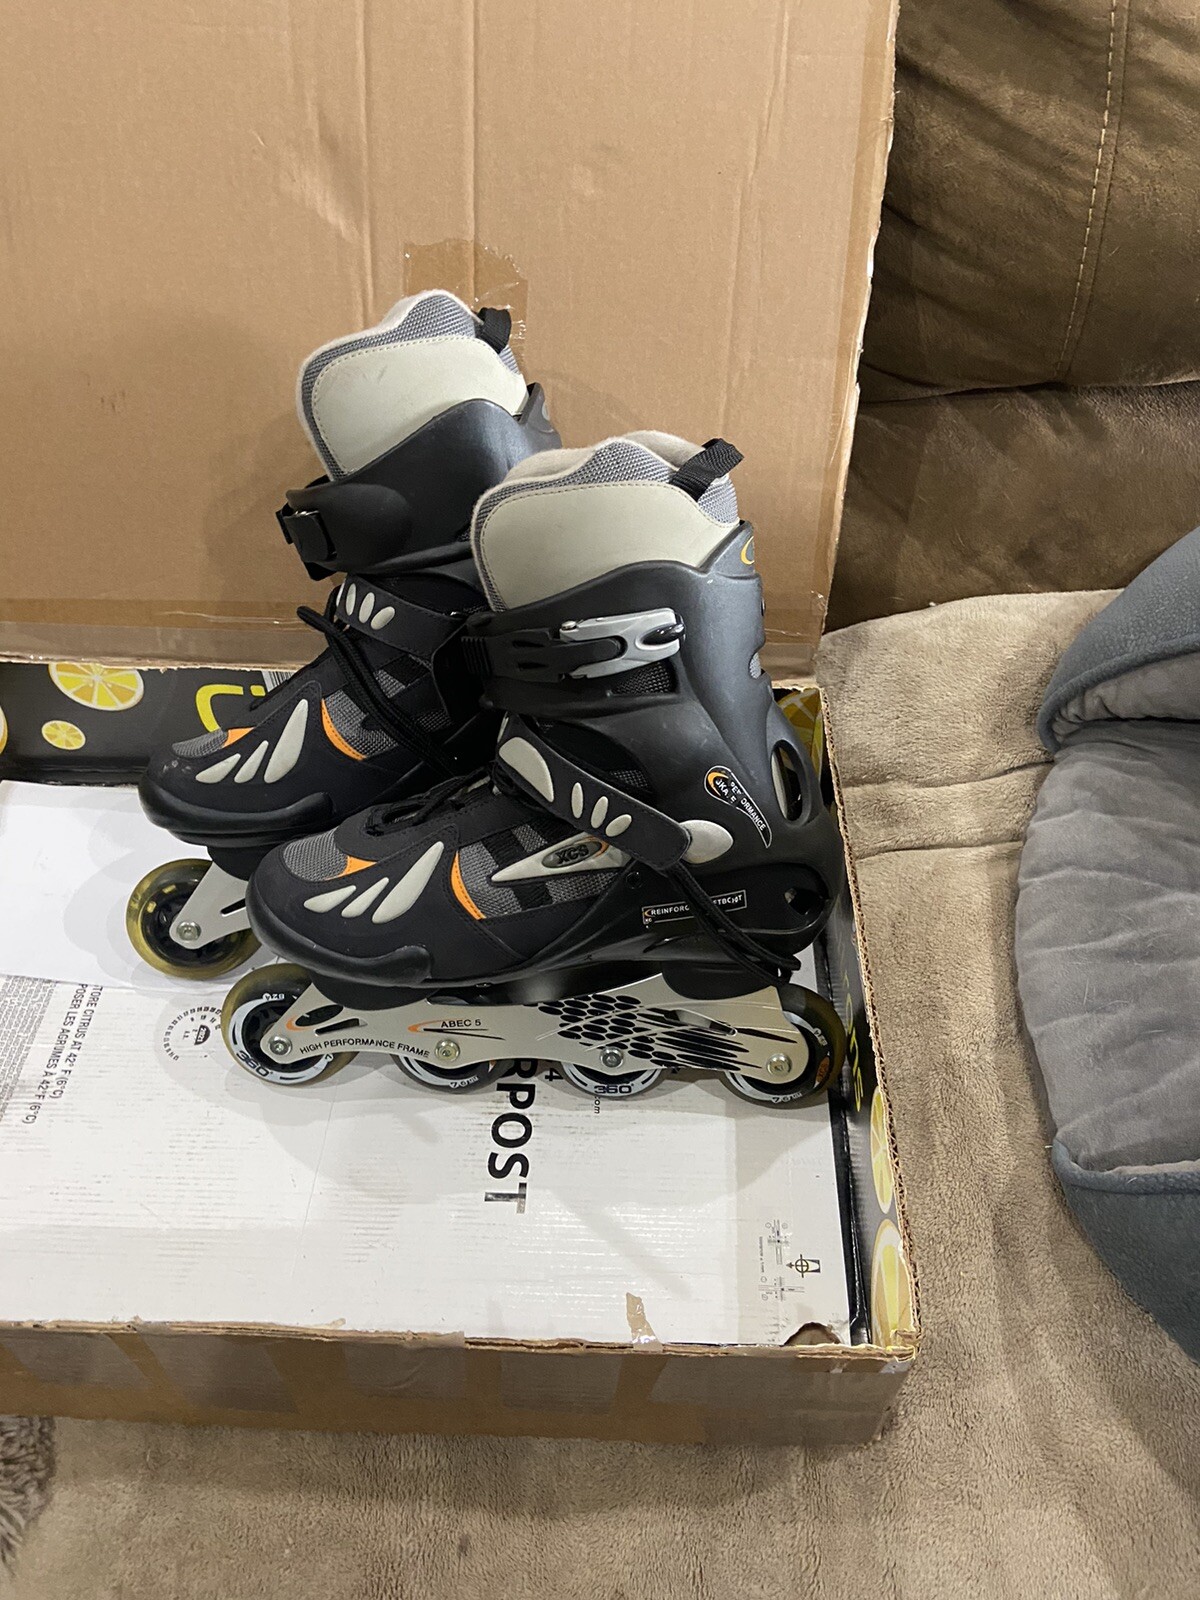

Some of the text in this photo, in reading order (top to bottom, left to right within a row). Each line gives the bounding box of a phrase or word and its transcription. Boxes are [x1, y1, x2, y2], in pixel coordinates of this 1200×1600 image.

[86, 984, 104, 1008] TORE
[63, 1011, 78, 1027] LES
[74, 1009, 95, 1039] CITRUS
[441, 1019, 472, 1028] ABEC
[46, 1028, 71, 1069] AGRUMES
[70, 1040, 83, 1051] AT
[299, 1038, 431, 1058] HIGH PERFORMANCE FRAME
